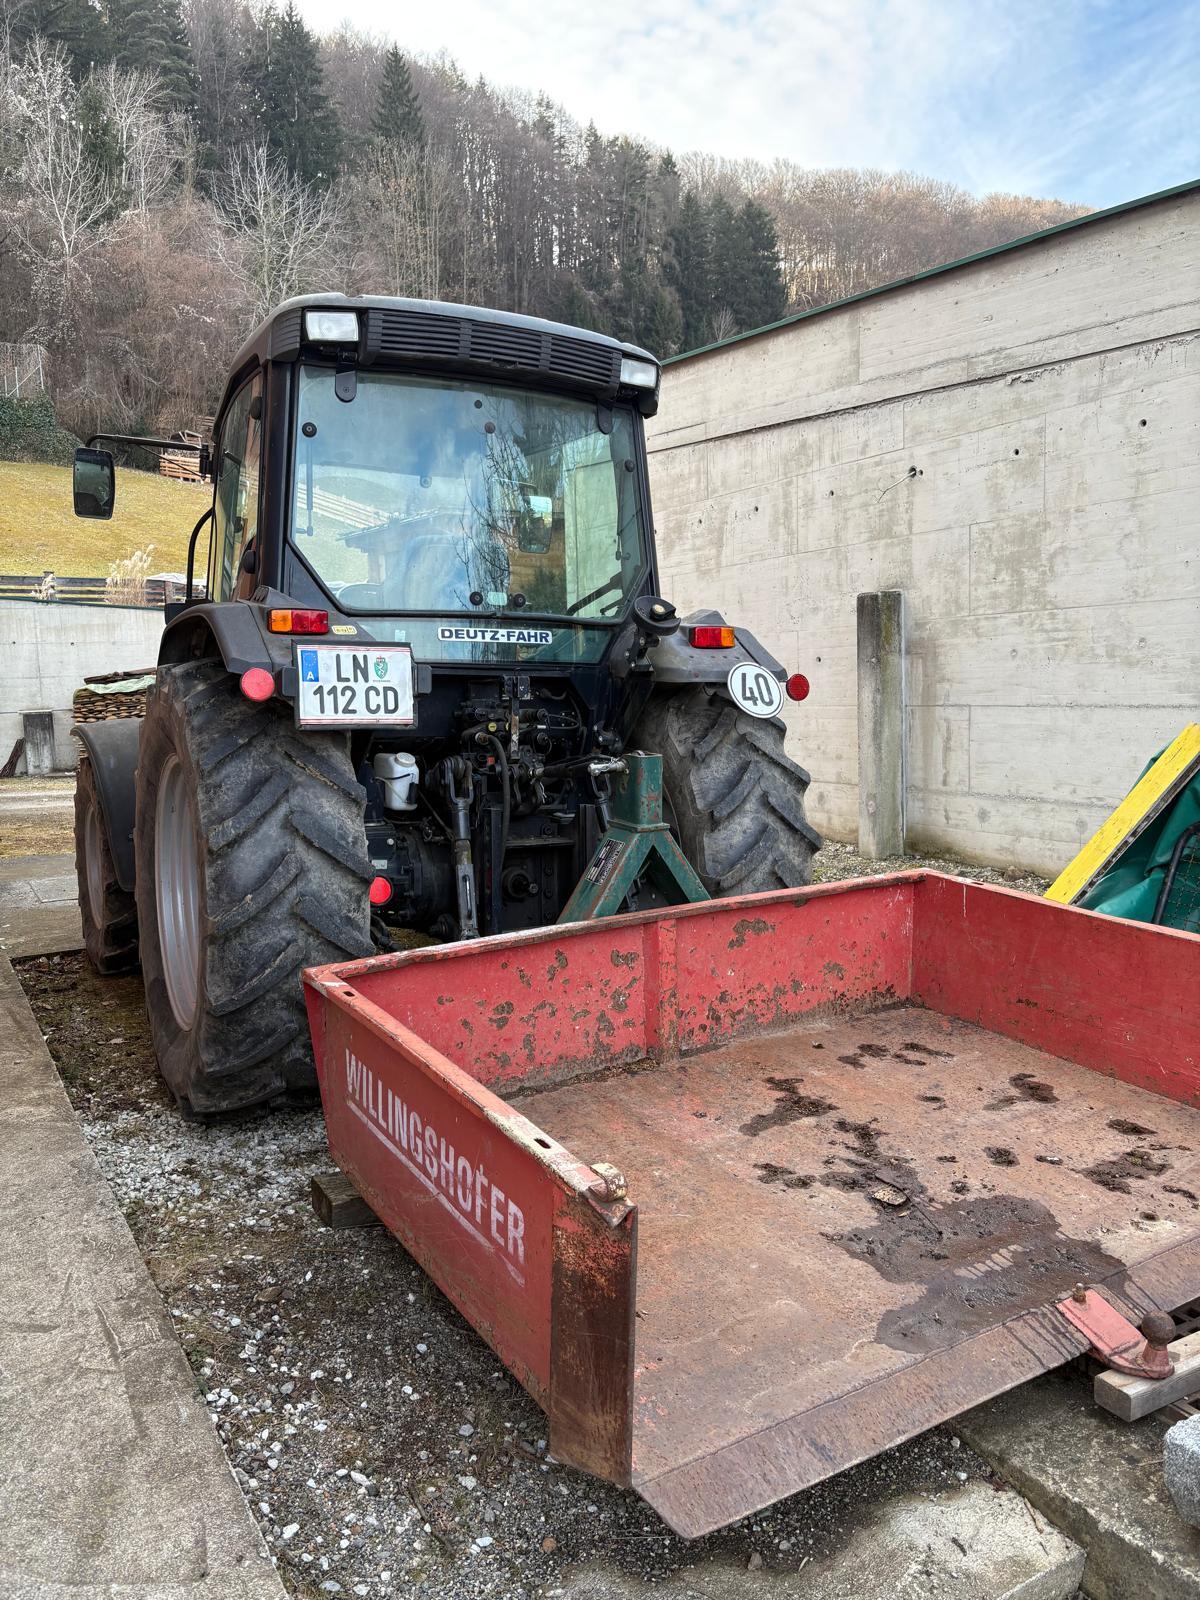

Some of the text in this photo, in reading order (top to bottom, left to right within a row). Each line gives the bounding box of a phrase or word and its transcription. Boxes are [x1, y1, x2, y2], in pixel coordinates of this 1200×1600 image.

[440, 628, 550, 642] DEUTZ-FAHR
[306, 671, 315, 680] A
[335, 653, 369, 683] LN
[313, 685, 399, 714] 112 CD
[741, 672, 774, 706] 40
[345, 1048, 525, 1264] WILLINGSHOFER
